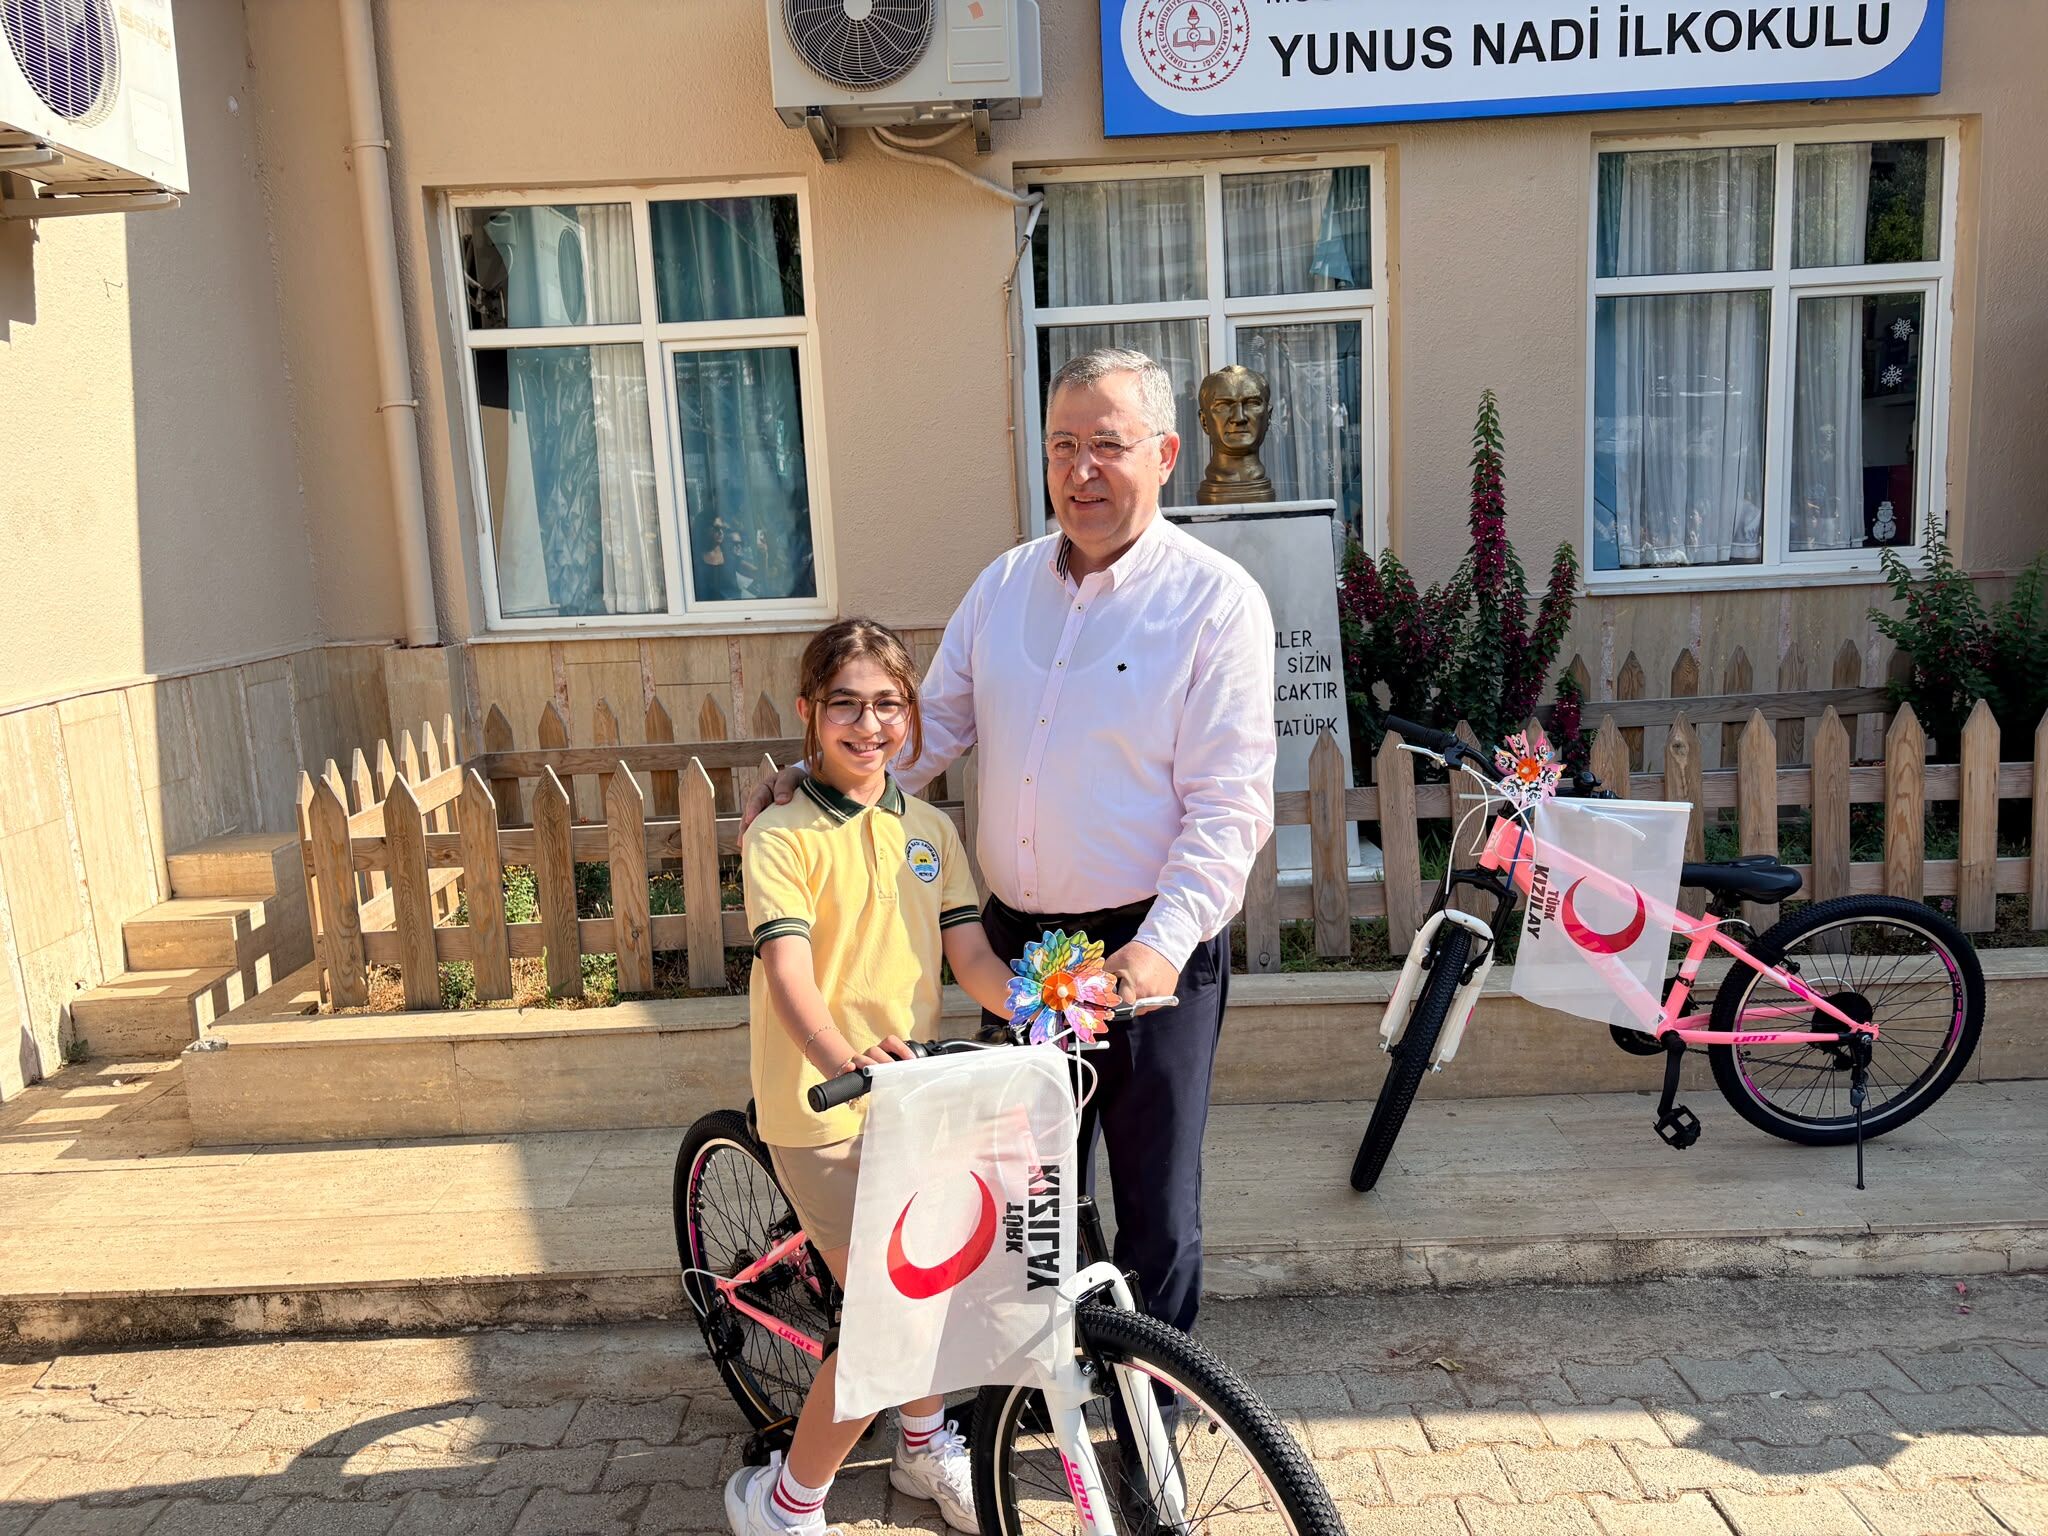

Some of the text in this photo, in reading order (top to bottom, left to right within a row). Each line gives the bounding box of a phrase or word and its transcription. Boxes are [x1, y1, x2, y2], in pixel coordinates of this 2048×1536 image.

[1268, 2, 1891, 77] YUNUS NADİ İLKOKULU
[1287, 650, 1331, 674] SİZİN
[1275, 682, 1338, 702] CAKTIR
[1275, 713, 1338, 737] TATÜRK
[1527, 864, 1550, 940] KIZILAY
[1543, 890, 1561, 922] TÜRK
